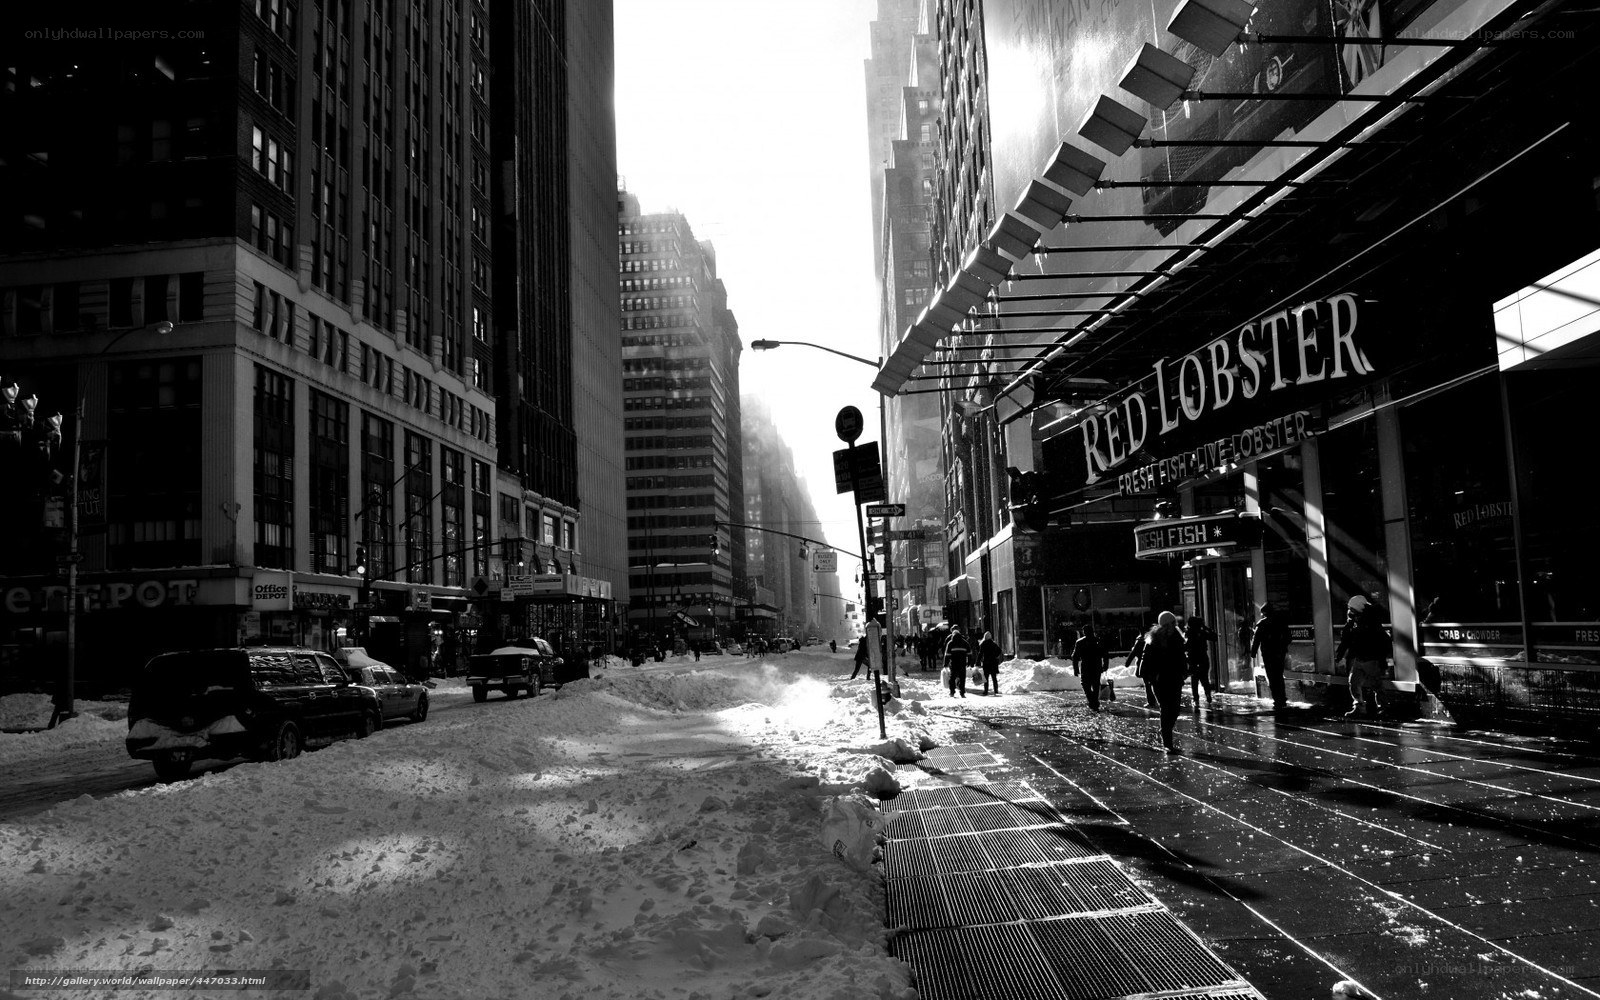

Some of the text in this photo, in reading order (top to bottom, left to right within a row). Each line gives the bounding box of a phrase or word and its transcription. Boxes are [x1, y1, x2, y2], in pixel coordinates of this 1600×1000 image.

[1079, 292, 1375, 485] RED LOBSTER
[1118, 411, 1314, 496] FRESH FISH LIVE LOBSTER
[1453, 508, 1474, 530] RED
[1168, 524, 1208, 547] FISH
[255, 584, 287, 593] Office
[255, 592, 287, 600] DEPOT
[1438, 629, 1500, 640] CRAB CHOWDER
[1575, 630, 1600, 642] FRES
